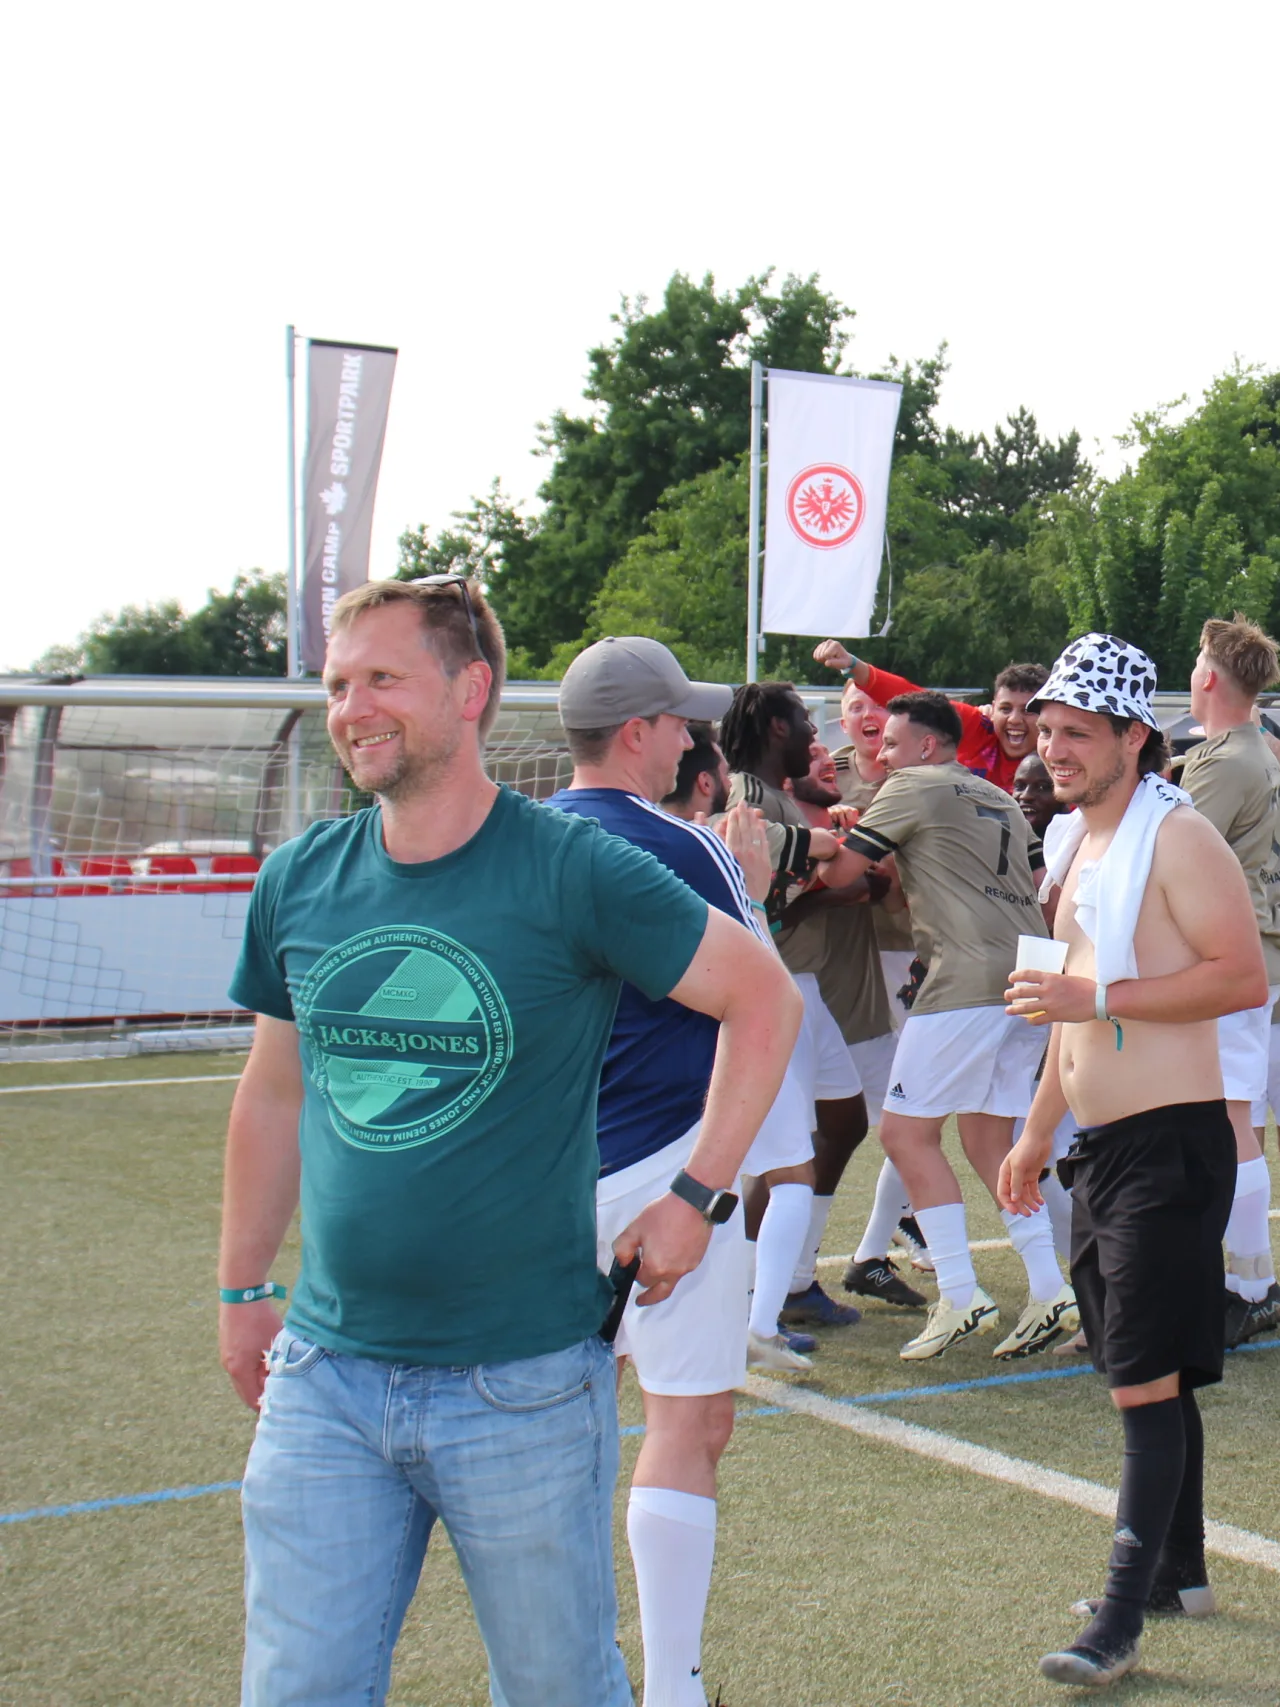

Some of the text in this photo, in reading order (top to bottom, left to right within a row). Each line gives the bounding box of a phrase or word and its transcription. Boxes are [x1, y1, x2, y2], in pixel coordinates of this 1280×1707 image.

[330, 353, 362, 477] SPORTPARK
[321, 521, 340, 583] CAMP
[975, 805, 1011, 876] 7
[340, 938, 372, 959] DENIM
[373, 933, 428, 945] AUTHENTIC
[313, 955, 340, 982] JONES
[430, 940, 480, 982] COLLECTION
[382, 988, 414, 998] MCMXC
[477, 981, 499, 1020] STUDIO
[318, 1025, 479, 1054] JACK&JONES
[493, 1021, 504, 1039] EST
[494, 1041, 504, 1064] 1990
[356, 1073, 396, 1084] AUTHENTIC
[415, 1079, 432, 1087] 1990
[461, 1087, 481, 1107] AND
[429, 1106, 460, 1130] JONES
[346, 1124, 392, 1142] AUTHENTI
[393, 1125, 427, 1142] DENIM
